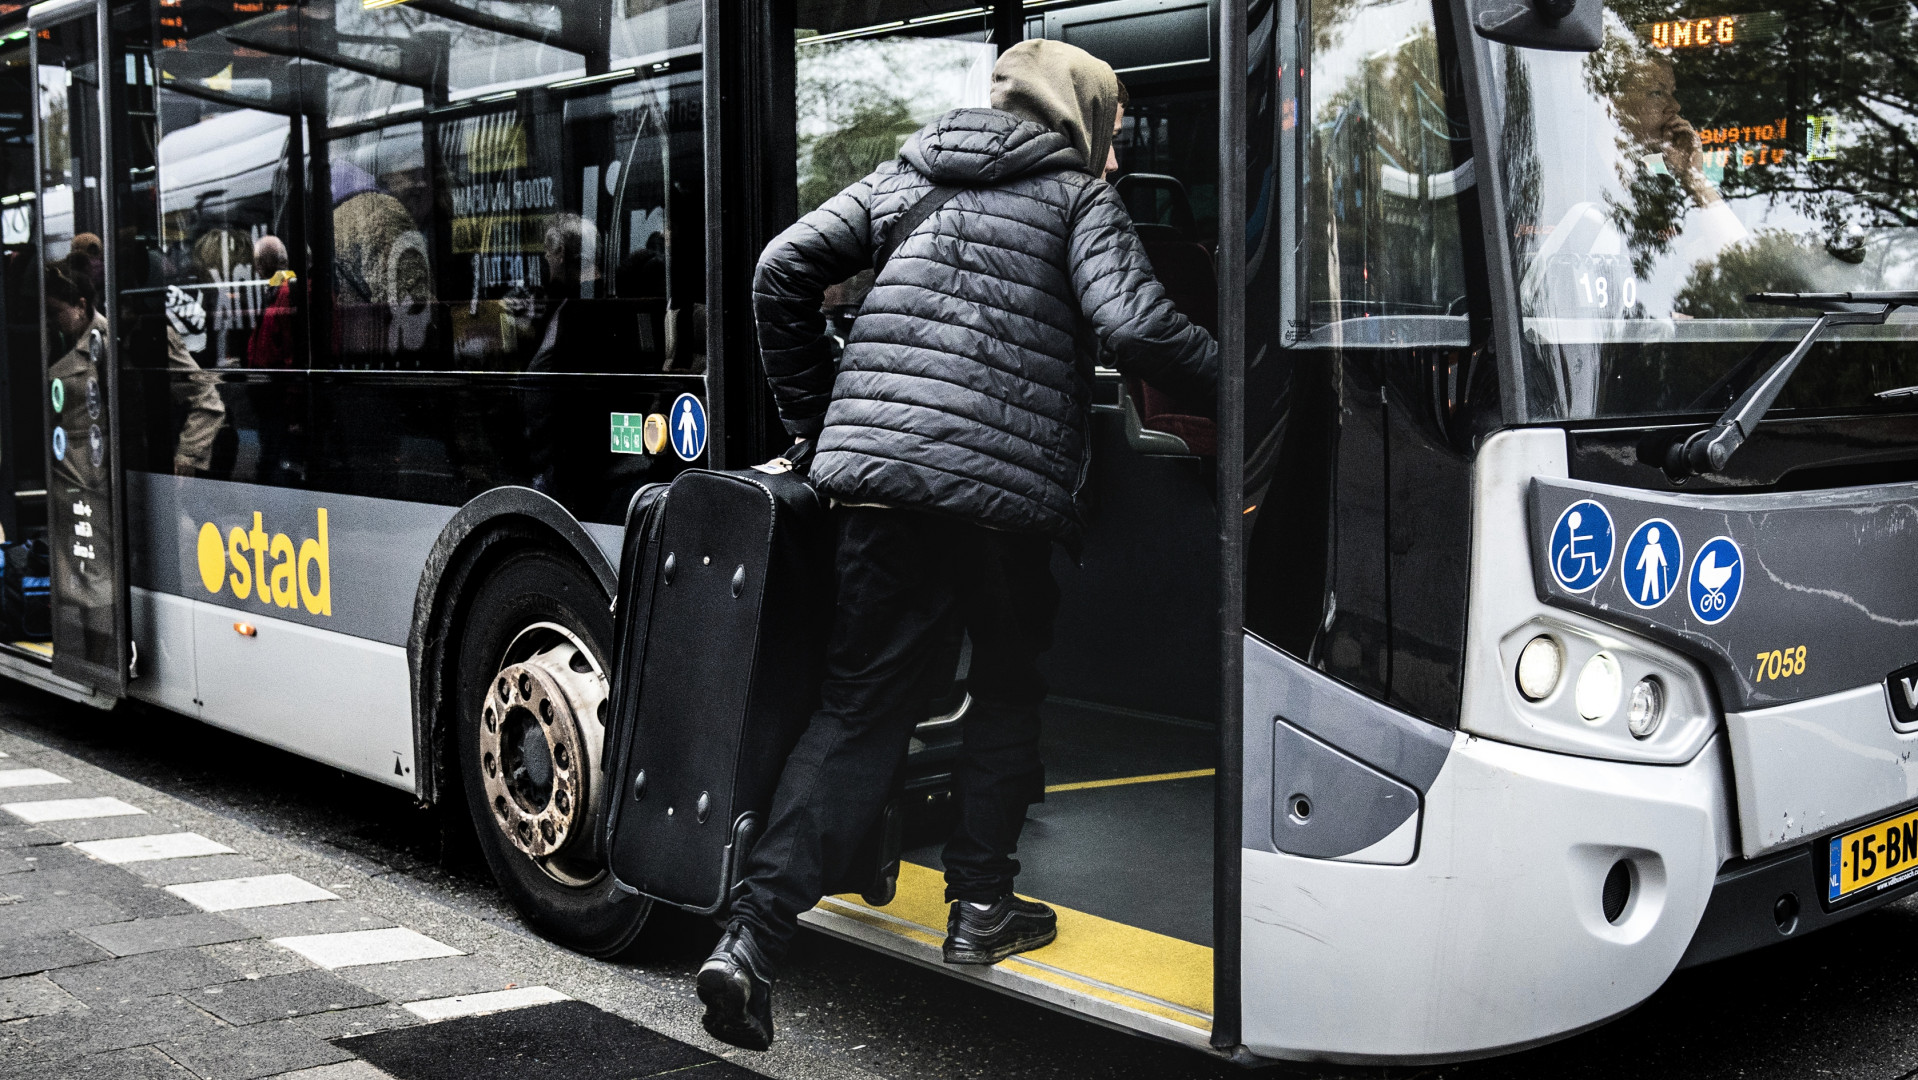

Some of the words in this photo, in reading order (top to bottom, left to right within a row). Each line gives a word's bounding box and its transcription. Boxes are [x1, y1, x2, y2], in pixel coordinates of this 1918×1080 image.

[1652, 17, 1734, 48] UMCG
[229, 507, 331, 616] stad
[1756, 645, 1807, 682] 7058
[1830, 874, 1839, 887] NL
